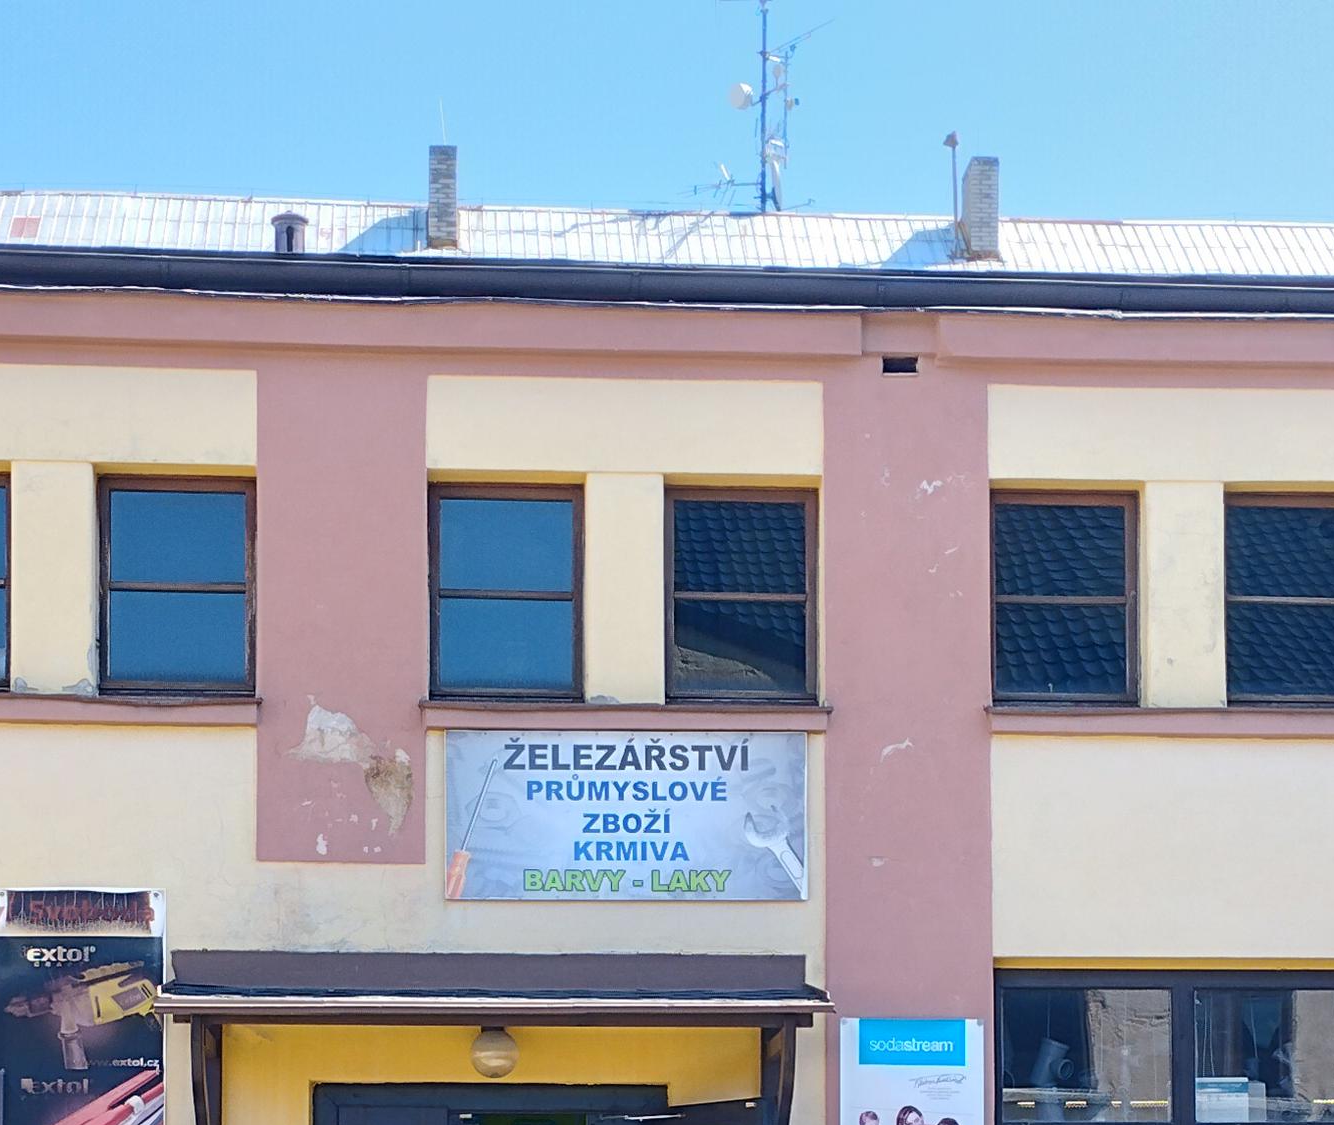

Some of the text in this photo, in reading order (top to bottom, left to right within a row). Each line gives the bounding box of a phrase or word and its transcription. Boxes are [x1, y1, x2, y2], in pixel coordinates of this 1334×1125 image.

[503, 737, 749, 771] ŽELEZÁŘSTVÍ
[526, 774, 728, 802] PRŮMYSLOVÉ
[582, 808, 671, 834] ZBOŽÍ
[573, 840, 690, 861] KRMIVA
[523, 869, 626, 892] BARVY
[651, 869, 732, 892] LAKY
[869, 1037, 954, 1052] sodastream
